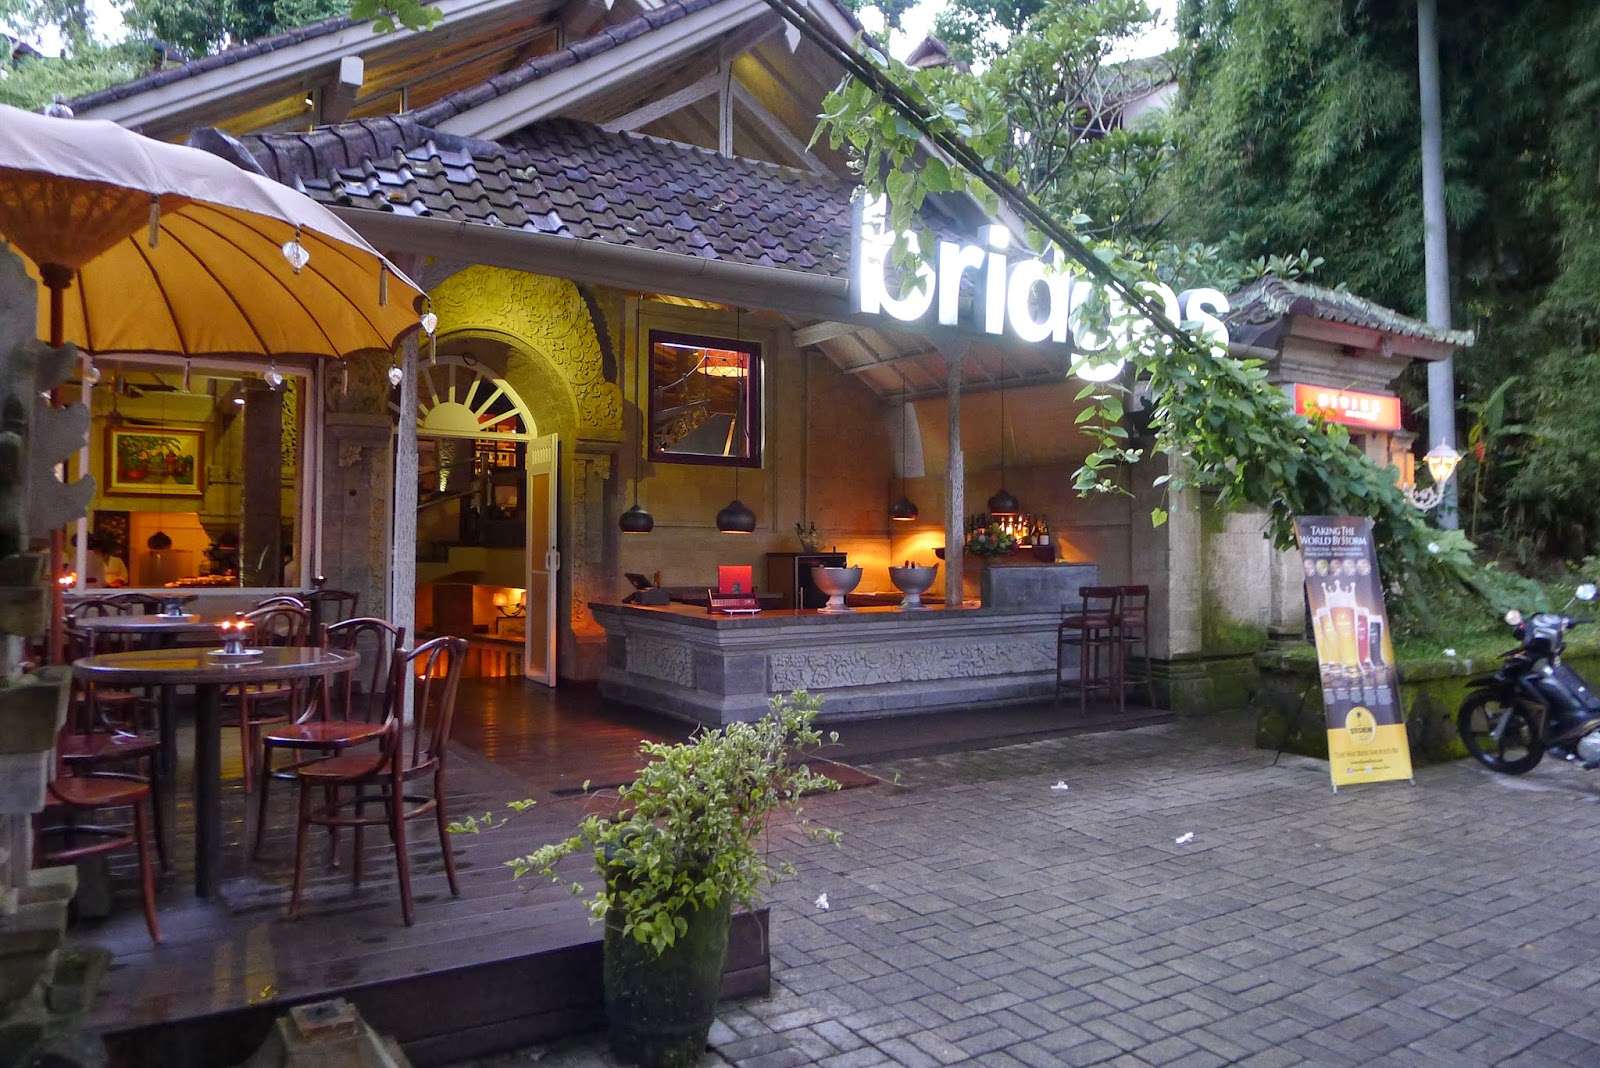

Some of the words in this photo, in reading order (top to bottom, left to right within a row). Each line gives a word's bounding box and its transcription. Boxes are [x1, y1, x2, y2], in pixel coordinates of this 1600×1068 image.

[1310, 525, 1340, 536] TAKING
[1341, 526, 1355, 536] THE
[1300, 535, 1331, 545] WORLD
[1332, 535, 1341, 546] BY
[1341, 535, 1367, 546] STORM
